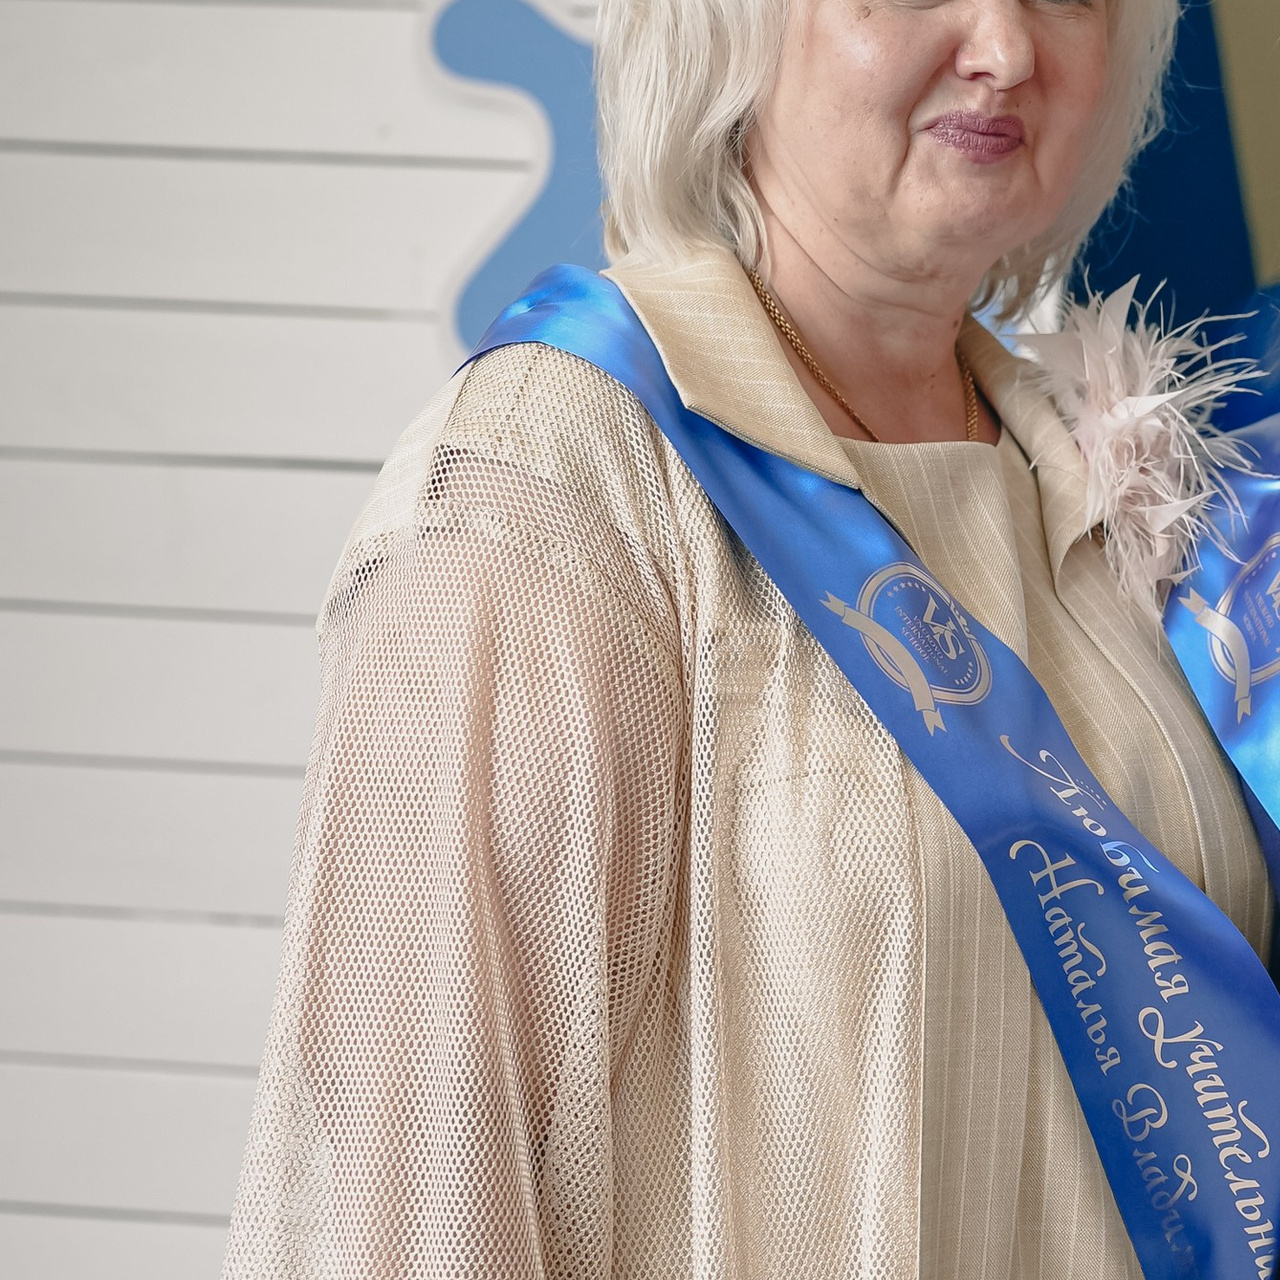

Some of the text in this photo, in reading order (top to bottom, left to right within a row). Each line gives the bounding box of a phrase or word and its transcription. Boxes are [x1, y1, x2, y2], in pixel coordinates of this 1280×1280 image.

[894, 605, 949, 676] INTERNATIONAL
[900, 626, 931, 665] SCHOOL
[912, 615, 945, 660] VNUKOVO
[999, 734, 1190, 1003] Любимая
[1008, 839, 1122, 1077] Наталья
